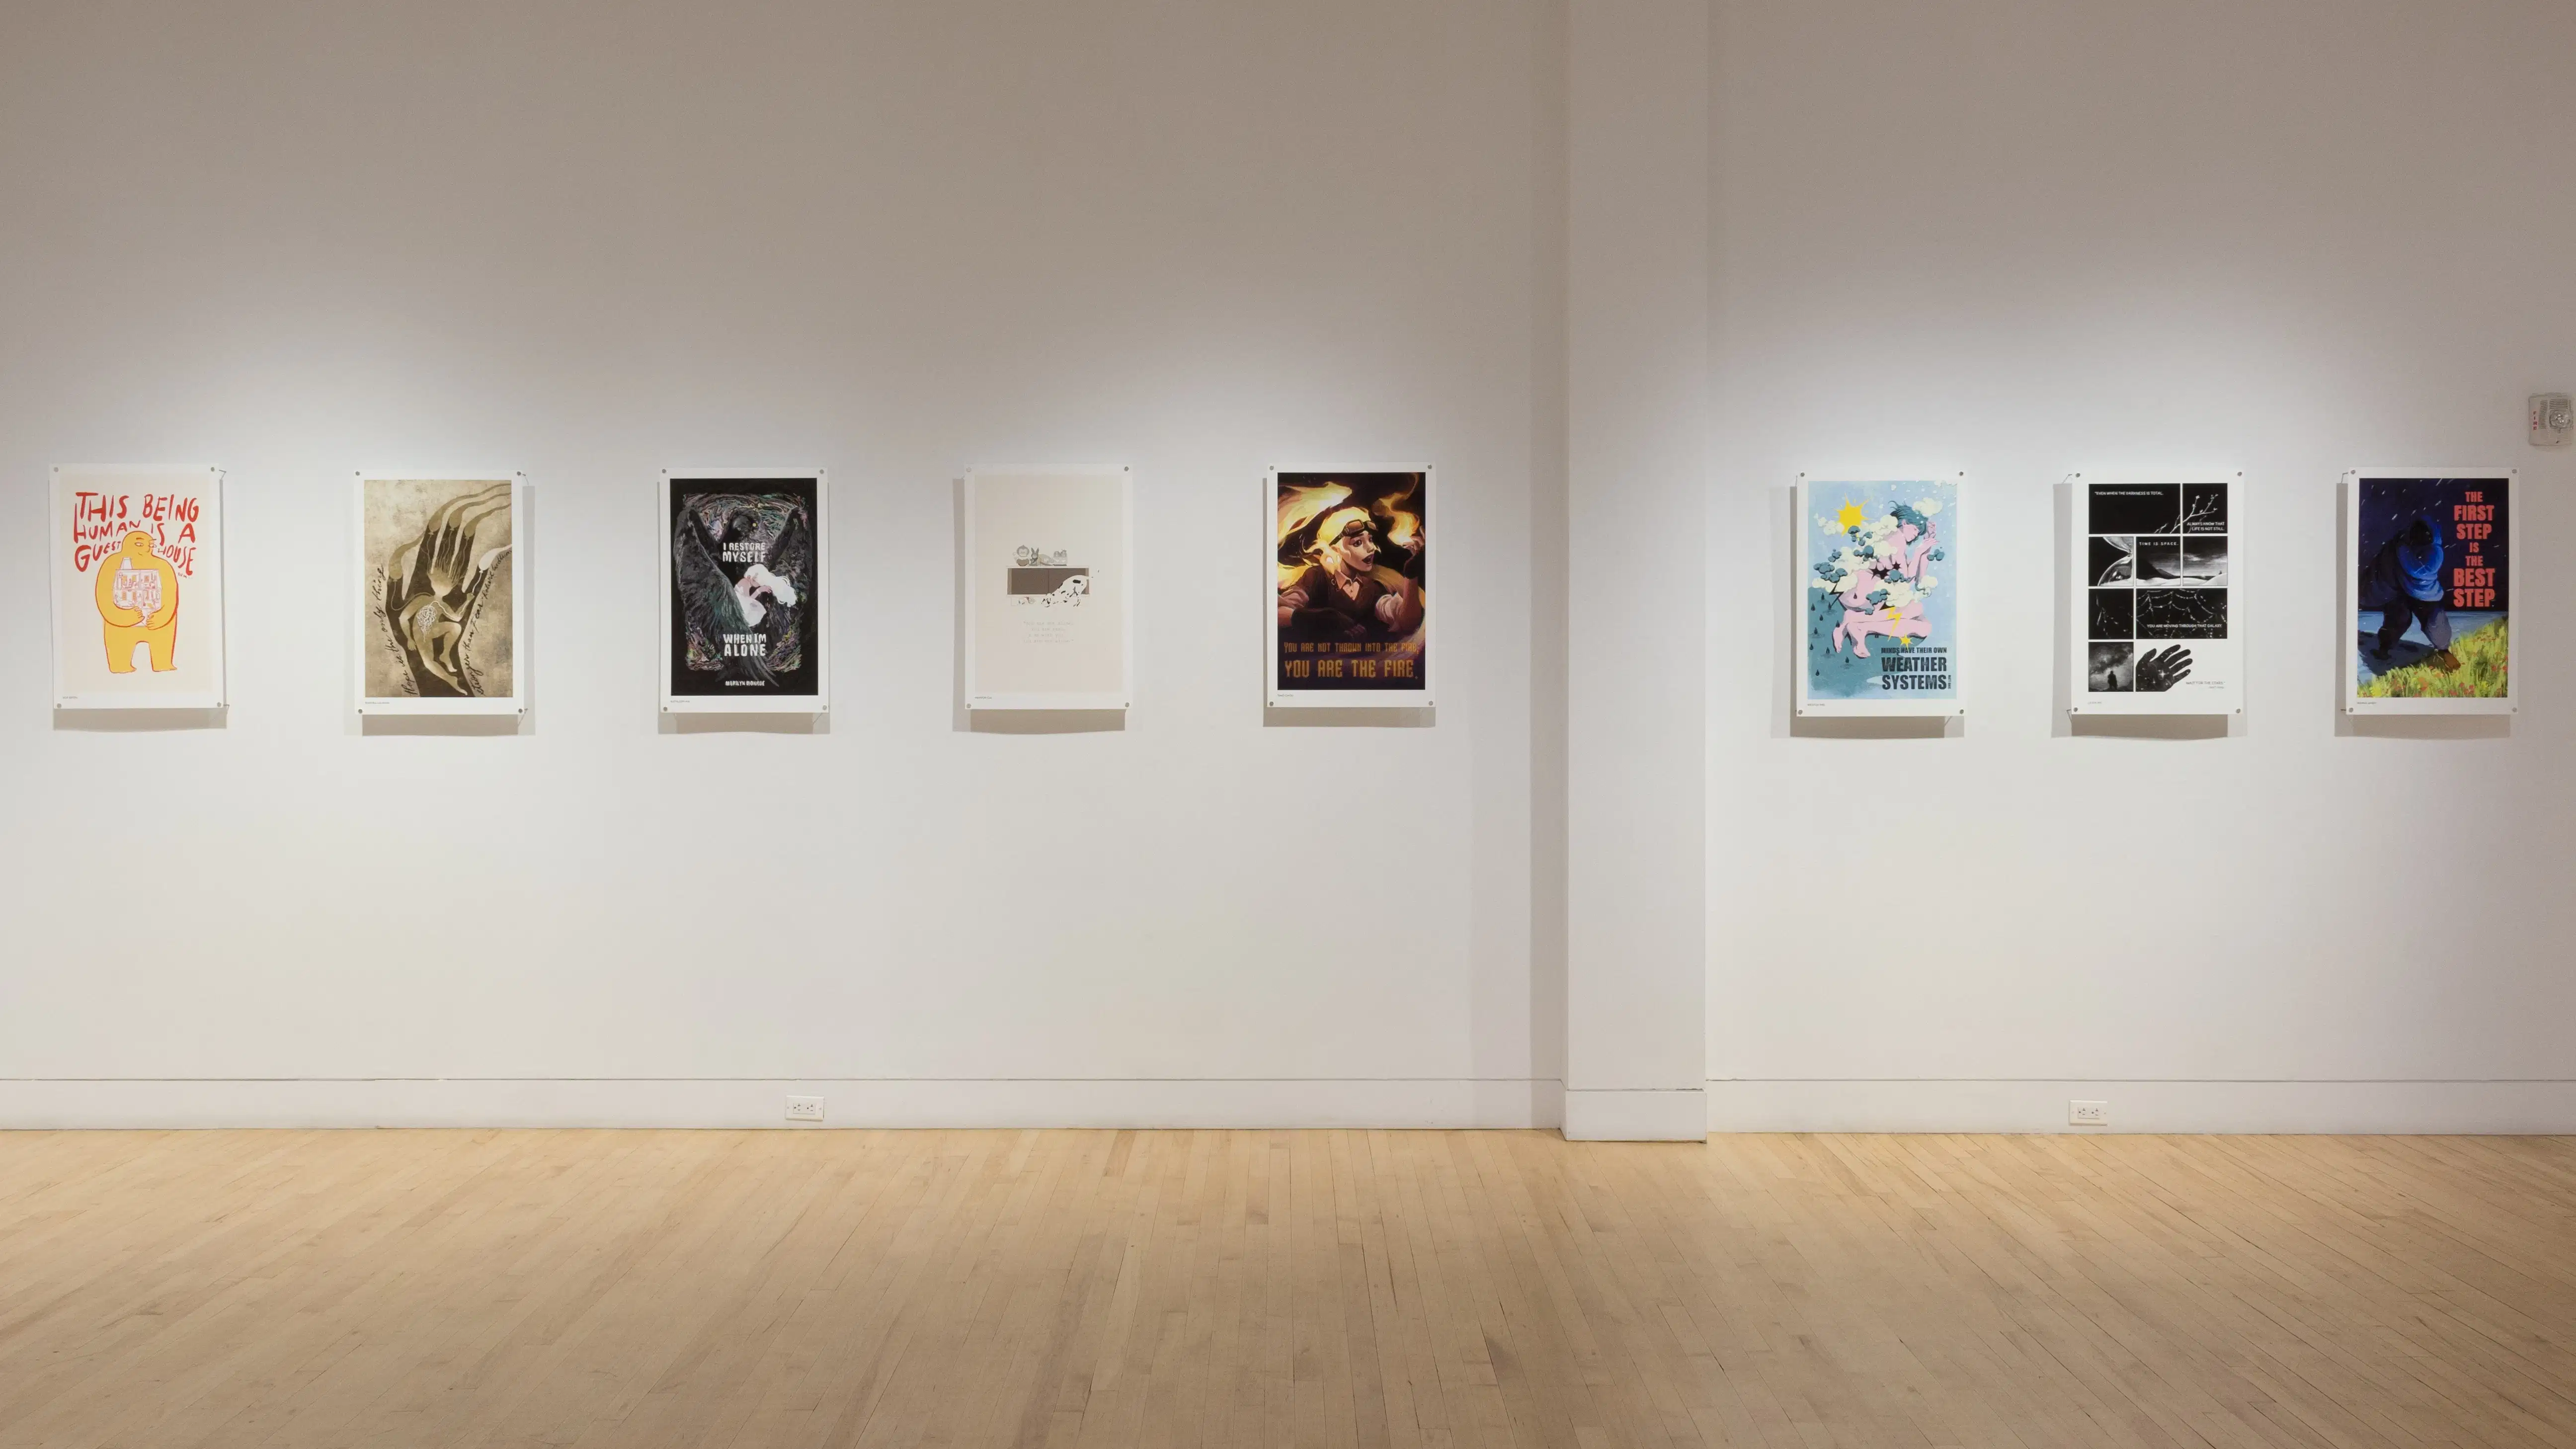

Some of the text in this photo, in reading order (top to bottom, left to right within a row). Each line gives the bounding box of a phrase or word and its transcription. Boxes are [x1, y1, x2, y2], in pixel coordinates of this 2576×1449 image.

[2465, 491, 2483, 503] THE
[76, 492, 199, 522] THIS BEING
[2454, 505, 2495, 521] FIRST
[74, 503, 196, 546] HUMAN IS A
[2456, 523, 2493, 540] STEP
[729, 542, 766, 551] RESTORE
[2469, 542, 2480, 553] IS
[75, 541, 196, 575] GUEST HOUSE
[723, 551, 766, 563] MYSELF
[2465, 556, 2483, 566] THE
[2453, 568, 2495, 587] BEST
[2453, 588, 2496, 607] STEP
[723, 634, 752, 644] WHEN
[724, 644, 766, 656] ALONE
[1284, 642, 1297, 653] YOU
[1301, 642, 1314, 652] ARE
[1317, 643, 1331, 652] NOT
[1335, 643, 1362, 652] THROWN
[1365, 643, 1381, 652] INTO
[1384, 643, 1398, 652] THE
[1284, 660, 1310, 678] YOU
[1317, 660, 1343, 678] ARE
[1351, 660, 1376, 678] THE
[1881, 657, 1947, 672] WEATHER
[1882, 674, 1947, 690] SYSTEMS
